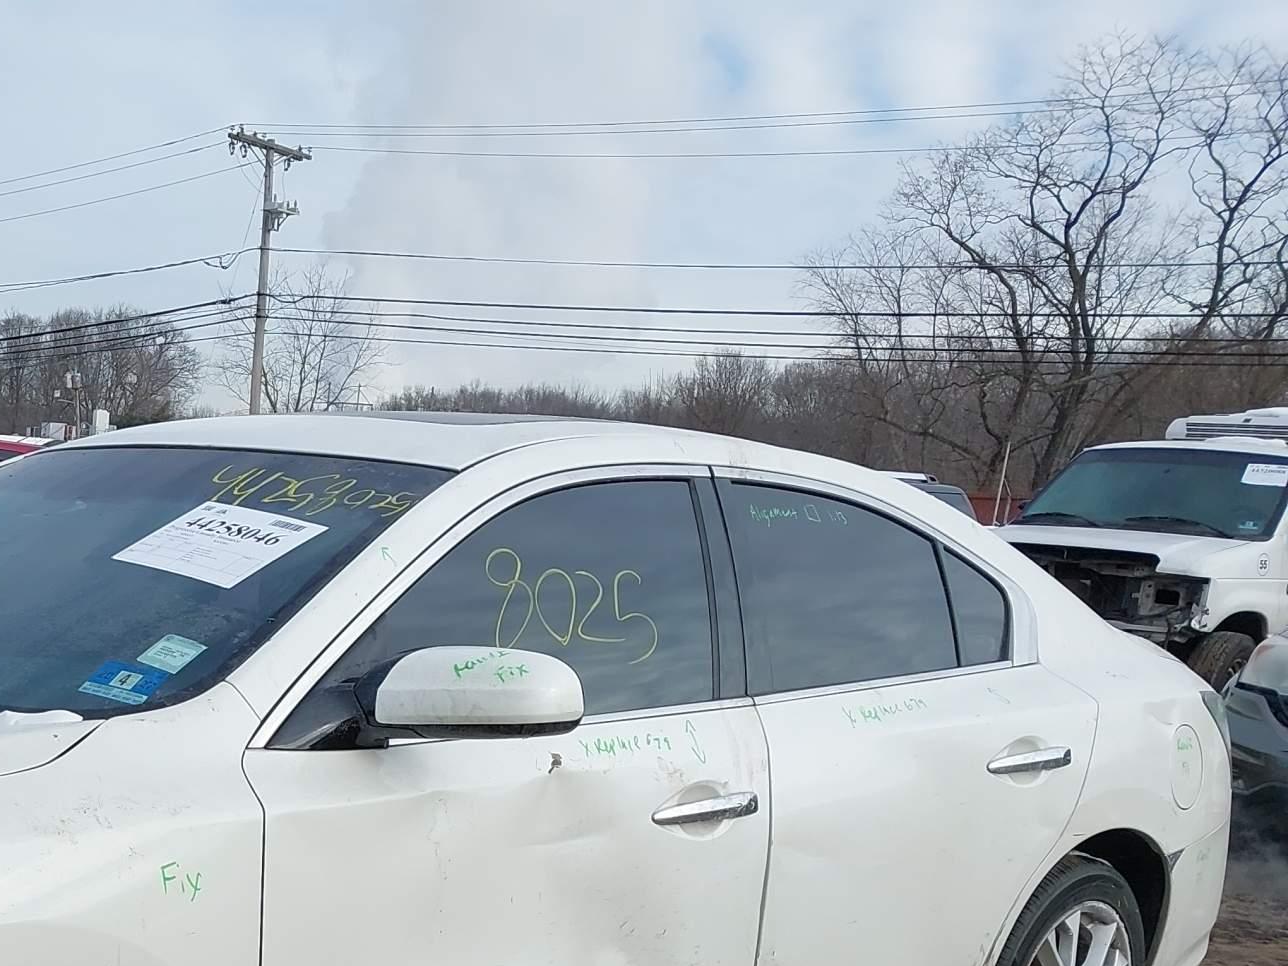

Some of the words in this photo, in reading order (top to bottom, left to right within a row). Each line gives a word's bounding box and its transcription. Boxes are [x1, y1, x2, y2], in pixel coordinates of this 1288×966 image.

[185, 516, 290, 546] 44258046
[485, 547, 659, 665] 8025
[118, 673, 132, 686] 4
